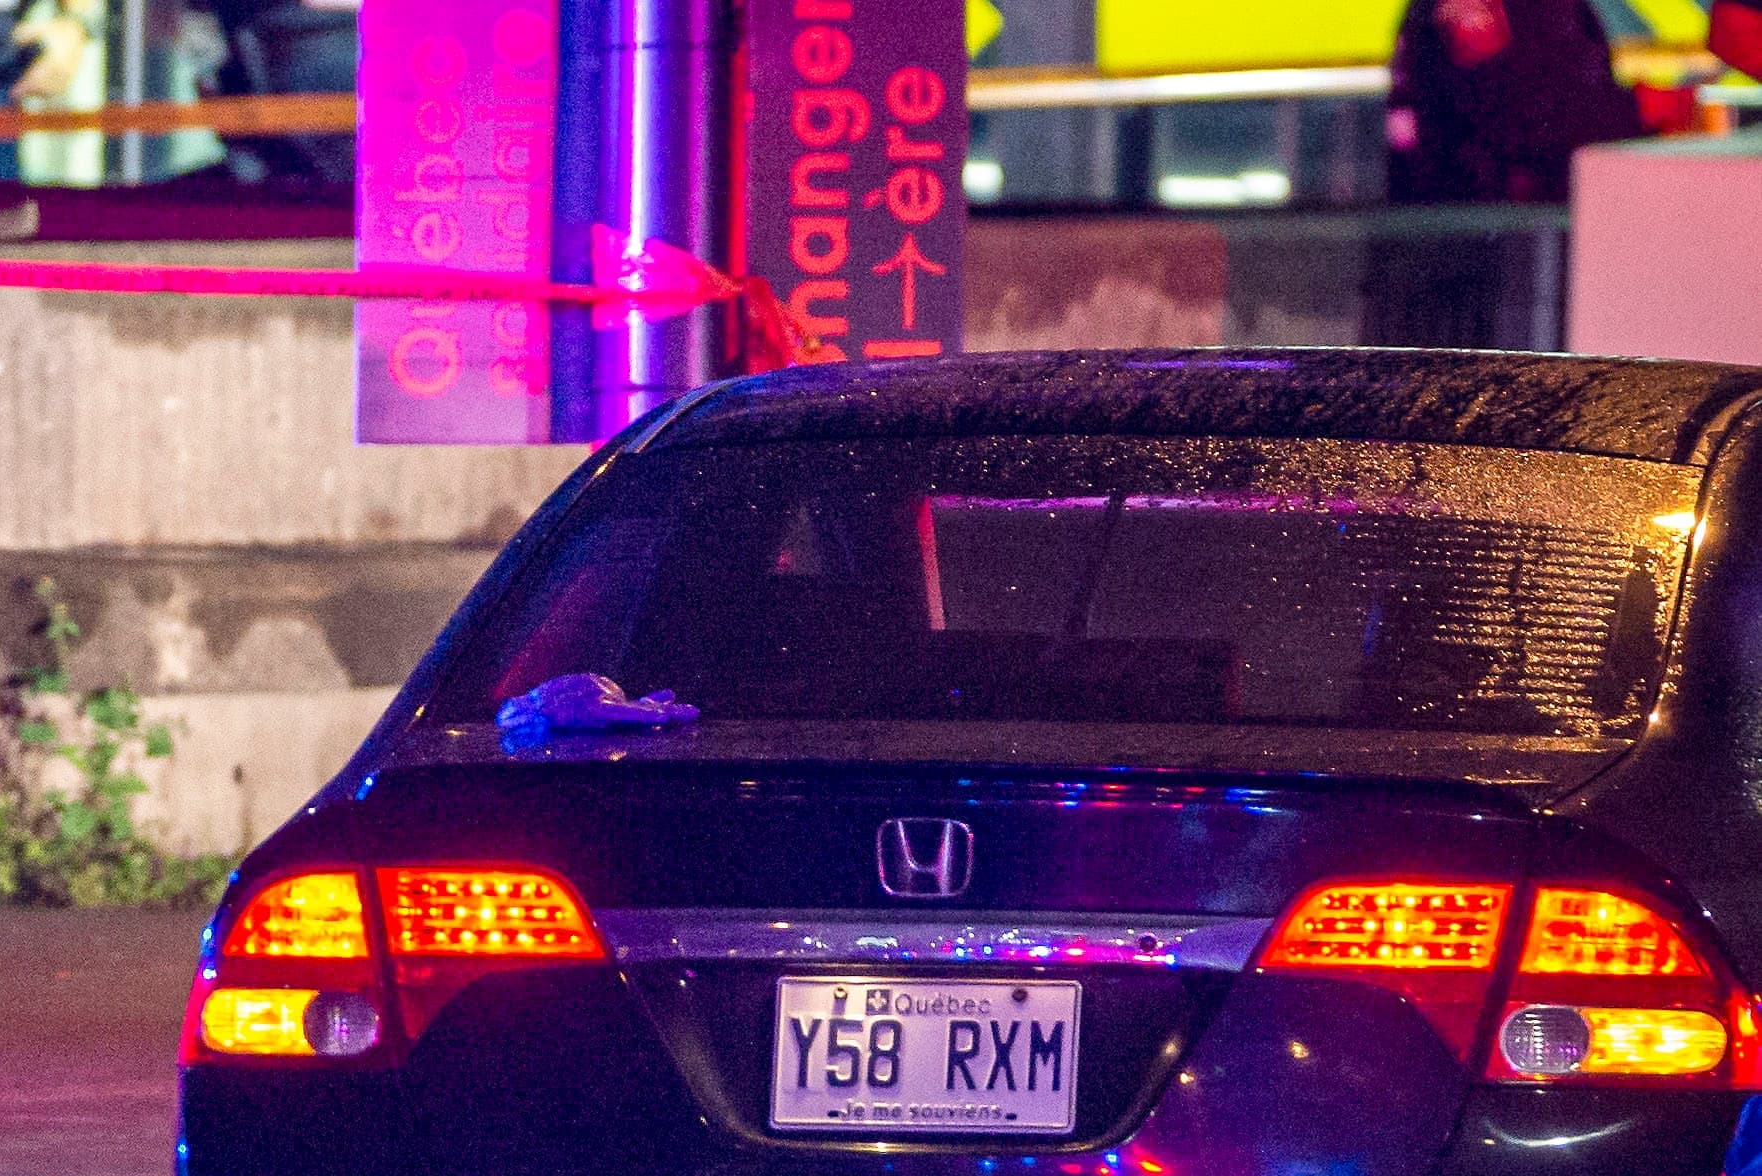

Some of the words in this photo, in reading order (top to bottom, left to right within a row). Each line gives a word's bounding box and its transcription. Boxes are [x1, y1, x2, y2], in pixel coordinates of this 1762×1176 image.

[472, 8, 548, 398] soidaire
[894, 991, 991, 1016] Québec
[790, 1017, 903, 1089] Y58
[946, 1019, 1066, 1092] RXM
[841, 1102, 866, 1120] Je
[872, 1104, 902, 1119] me
[909, 1104, 1003, 1121] souviens
